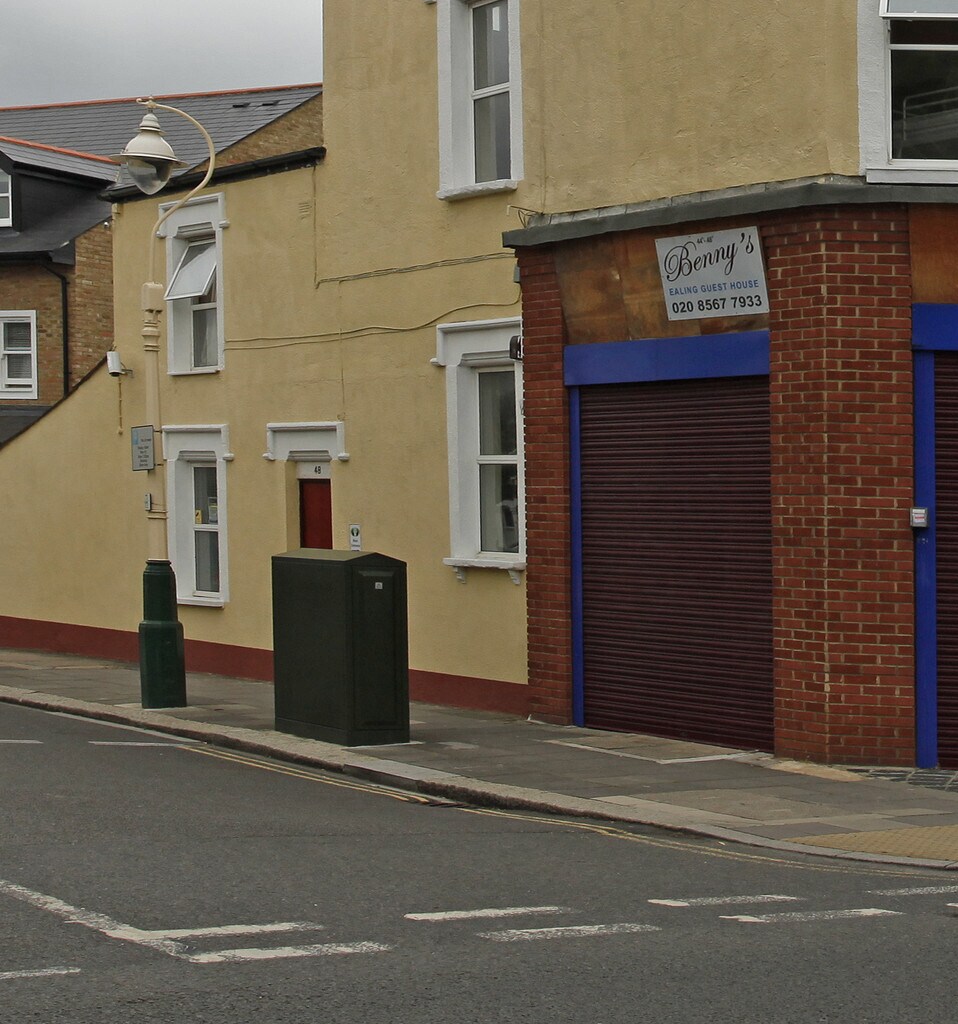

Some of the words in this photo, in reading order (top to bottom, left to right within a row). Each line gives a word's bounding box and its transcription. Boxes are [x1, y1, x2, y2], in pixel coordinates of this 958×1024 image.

[664, 232, 754, 282] Benny's
[669, 285, 698, 296] EALING
[700, 282, 727, 293] GUEST
[730, 279, 759, 290] HOUSE
[672, 300, 694, 314] 020
[697, 297, 727, 311] 8567
[730, 294, 762, 308] 7933
[314, 465, 322, 475] 48
